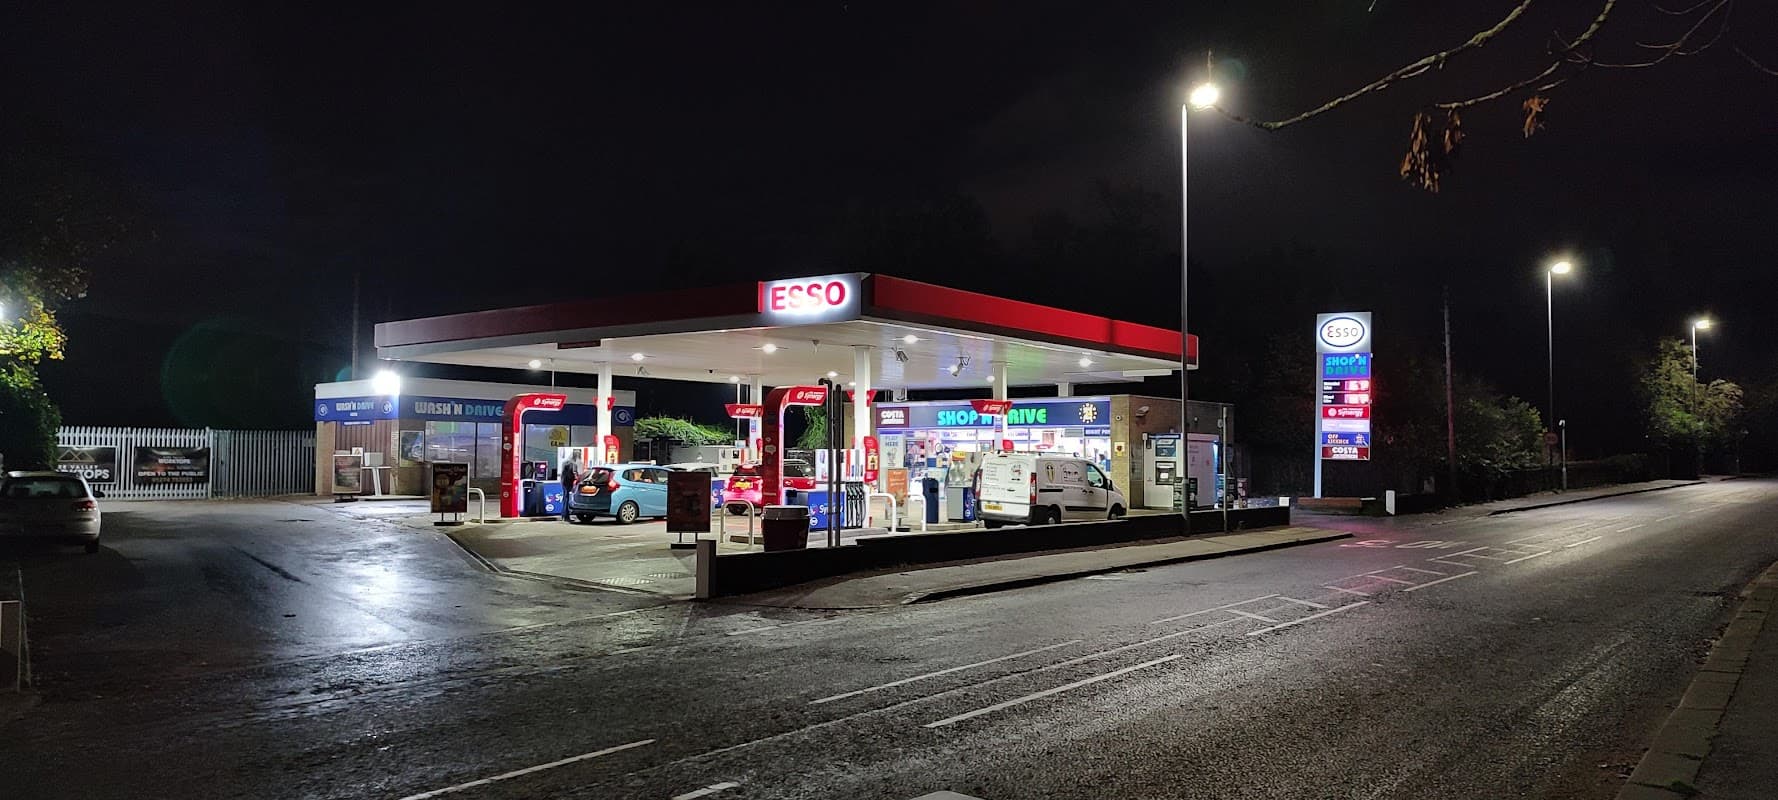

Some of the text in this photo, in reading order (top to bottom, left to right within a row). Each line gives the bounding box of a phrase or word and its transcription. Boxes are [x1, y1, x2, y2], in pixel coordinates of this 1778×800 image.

[771, 281, 846, 311] ESSO
[465, 404, 504, 417] DRIVE
[1007, 408, 1047, 425] RIVE
